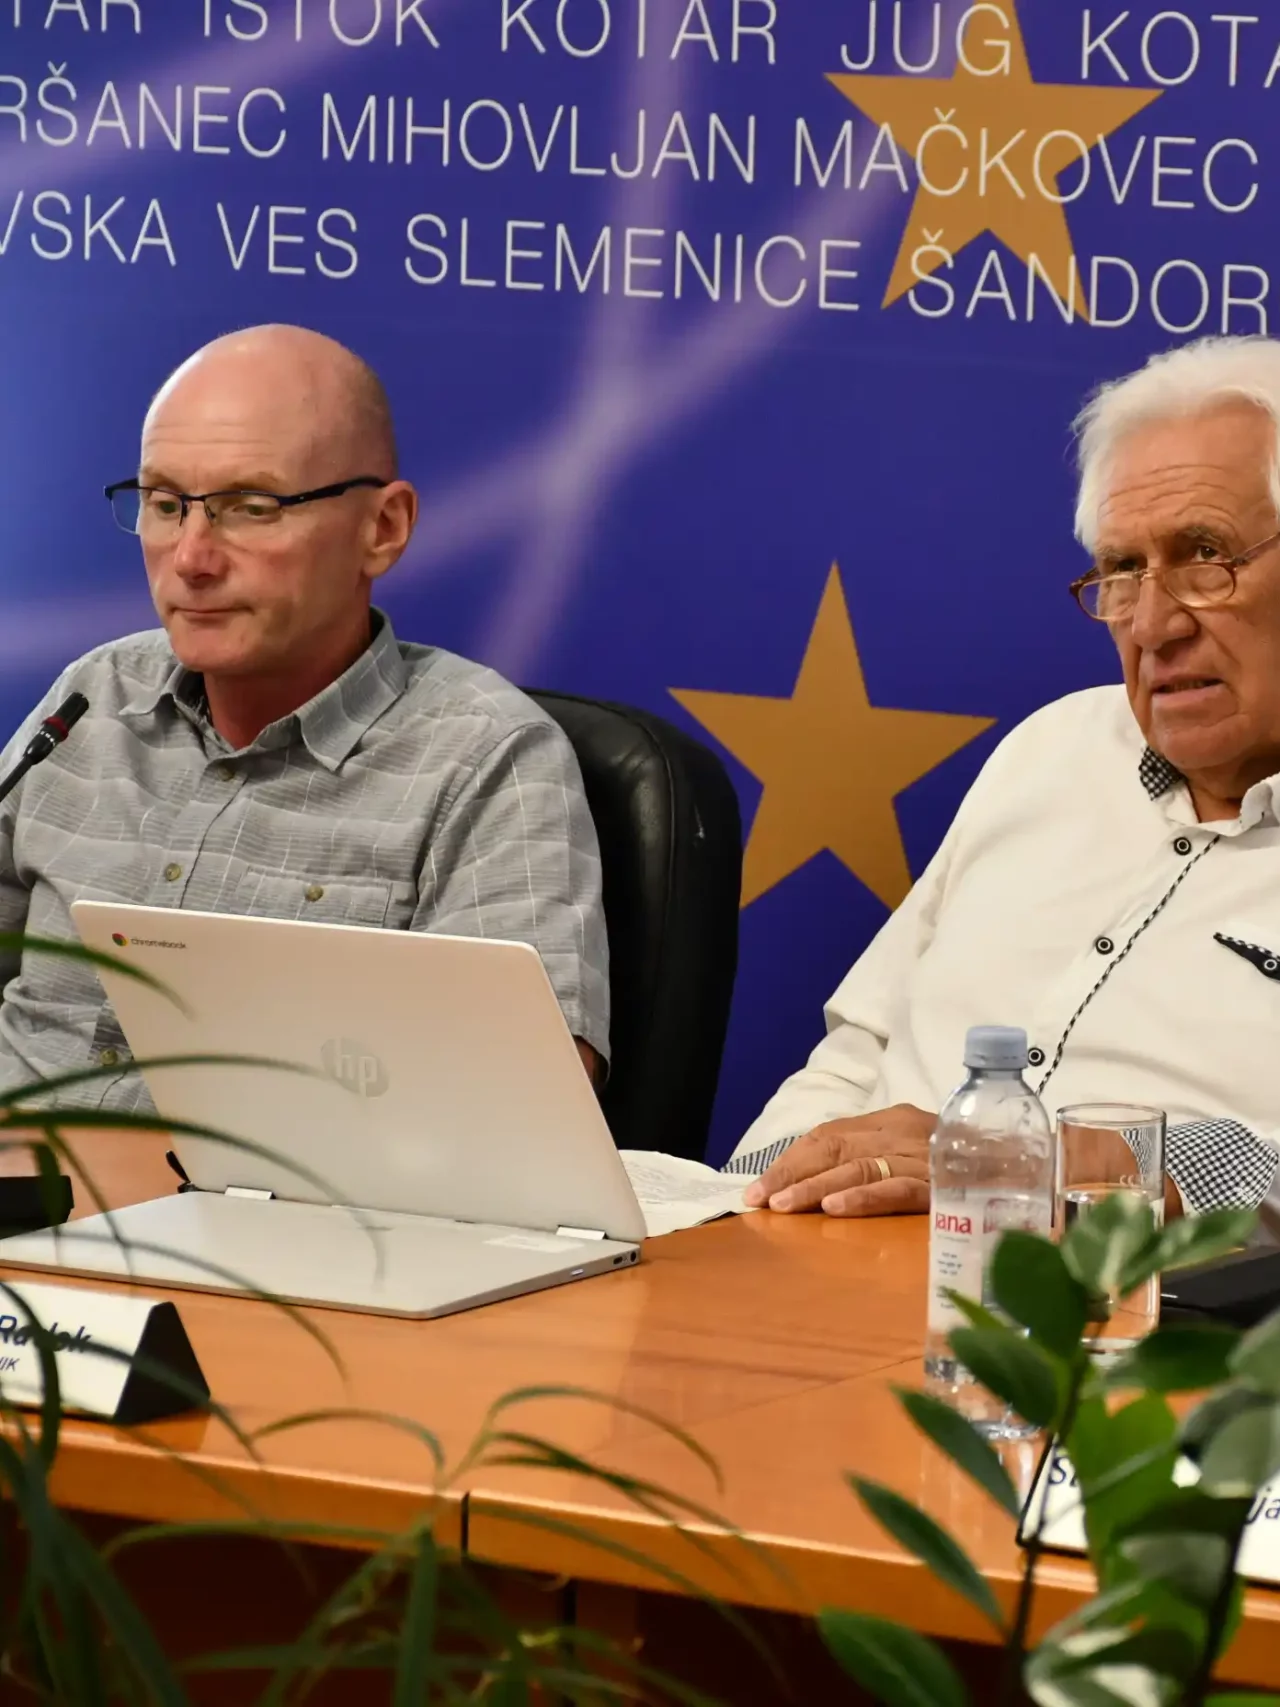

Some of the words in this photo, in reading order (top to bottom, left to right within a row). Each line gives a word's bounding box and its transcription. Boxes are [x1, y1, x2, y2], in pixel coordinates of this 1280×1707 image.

[500, 0, 777, 66] KOTAR
[840, 0, 1011, 77] JUG
[321, 91, 756, 185] MIHOVLJAN
[793, 107, 1259, 214] MAČKOVEC
[216, 201, 359, 280] VES
[404, 212, 862, 312] SLEMENICE
[330, 1037, 381, 1099] hp
